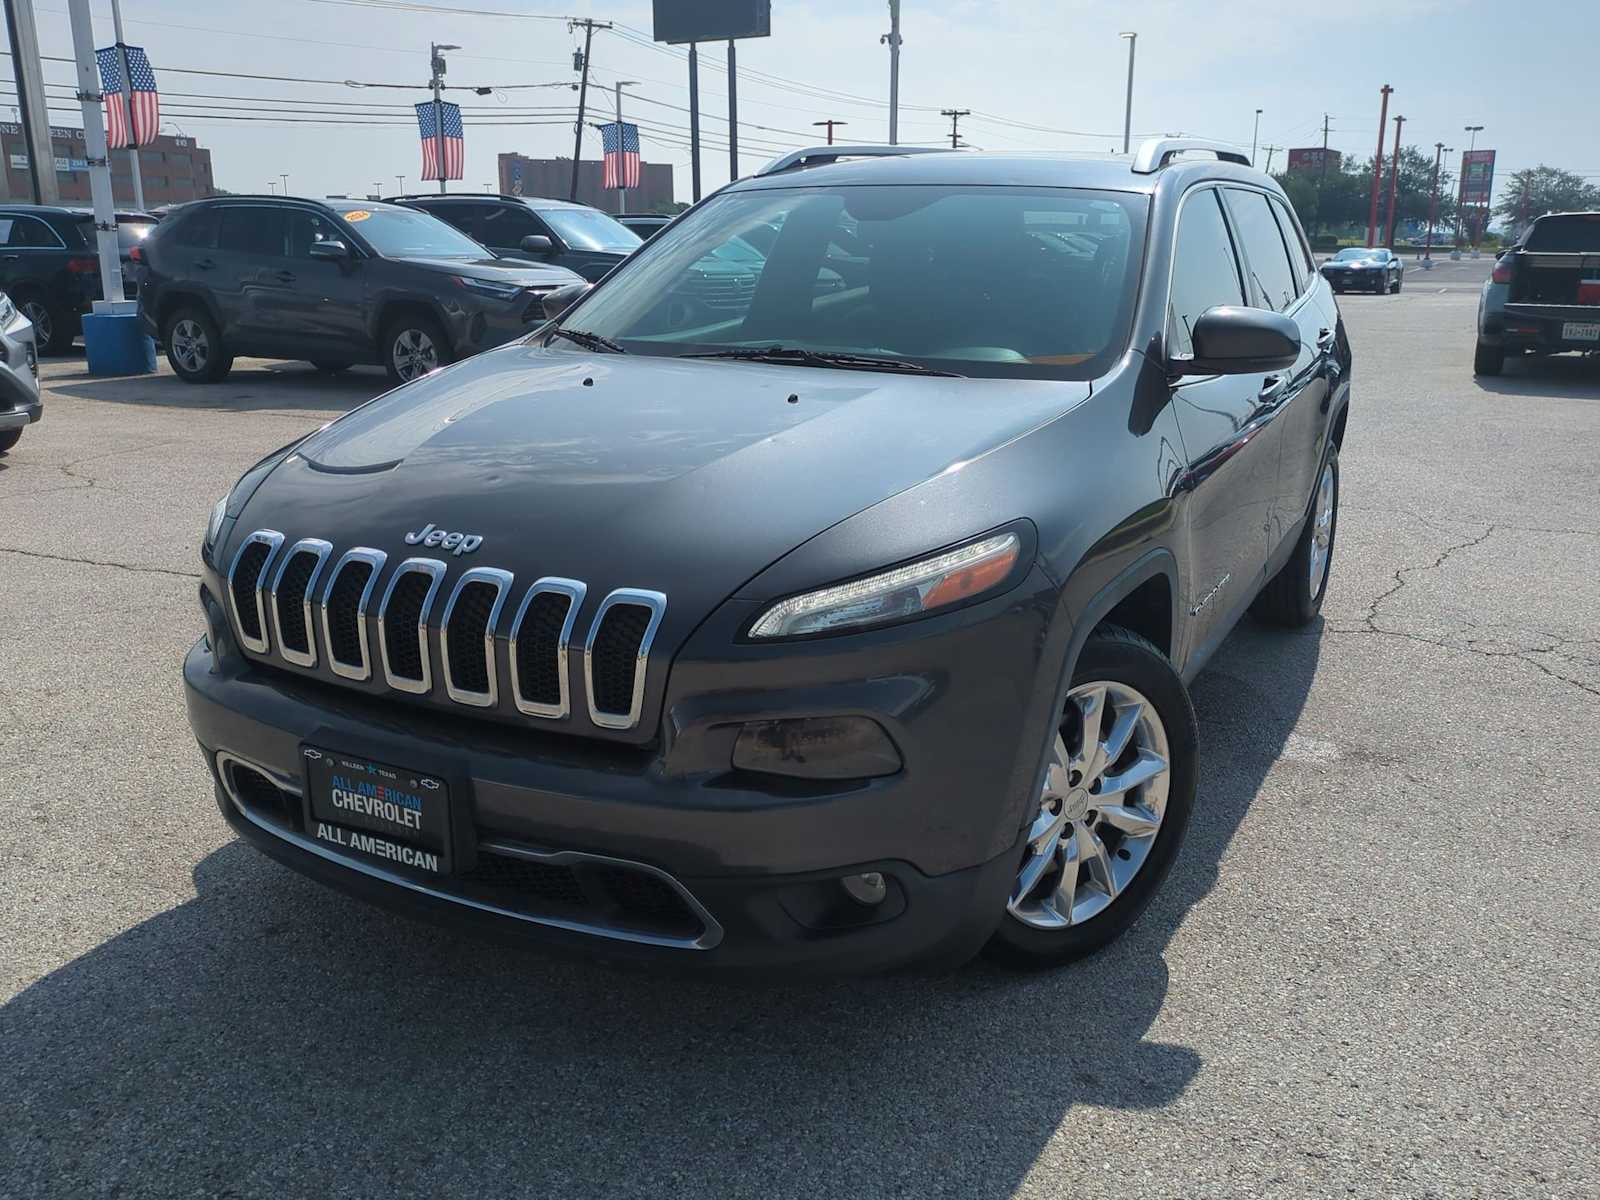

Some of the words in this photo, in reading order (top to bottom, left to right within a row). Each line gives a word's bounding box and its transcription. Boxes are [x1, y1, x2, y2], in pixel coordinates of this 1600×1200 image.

[404, 523, 483, 556] Jeep
[331, 775, 357, 793] ALL
[357, 781, 423, 809] AMERICAN
[331, 788, 422, 830] CHEVROLET
[316, 822, 347, 846] ALL
[349, 832, 438, 872] AMERICAN
